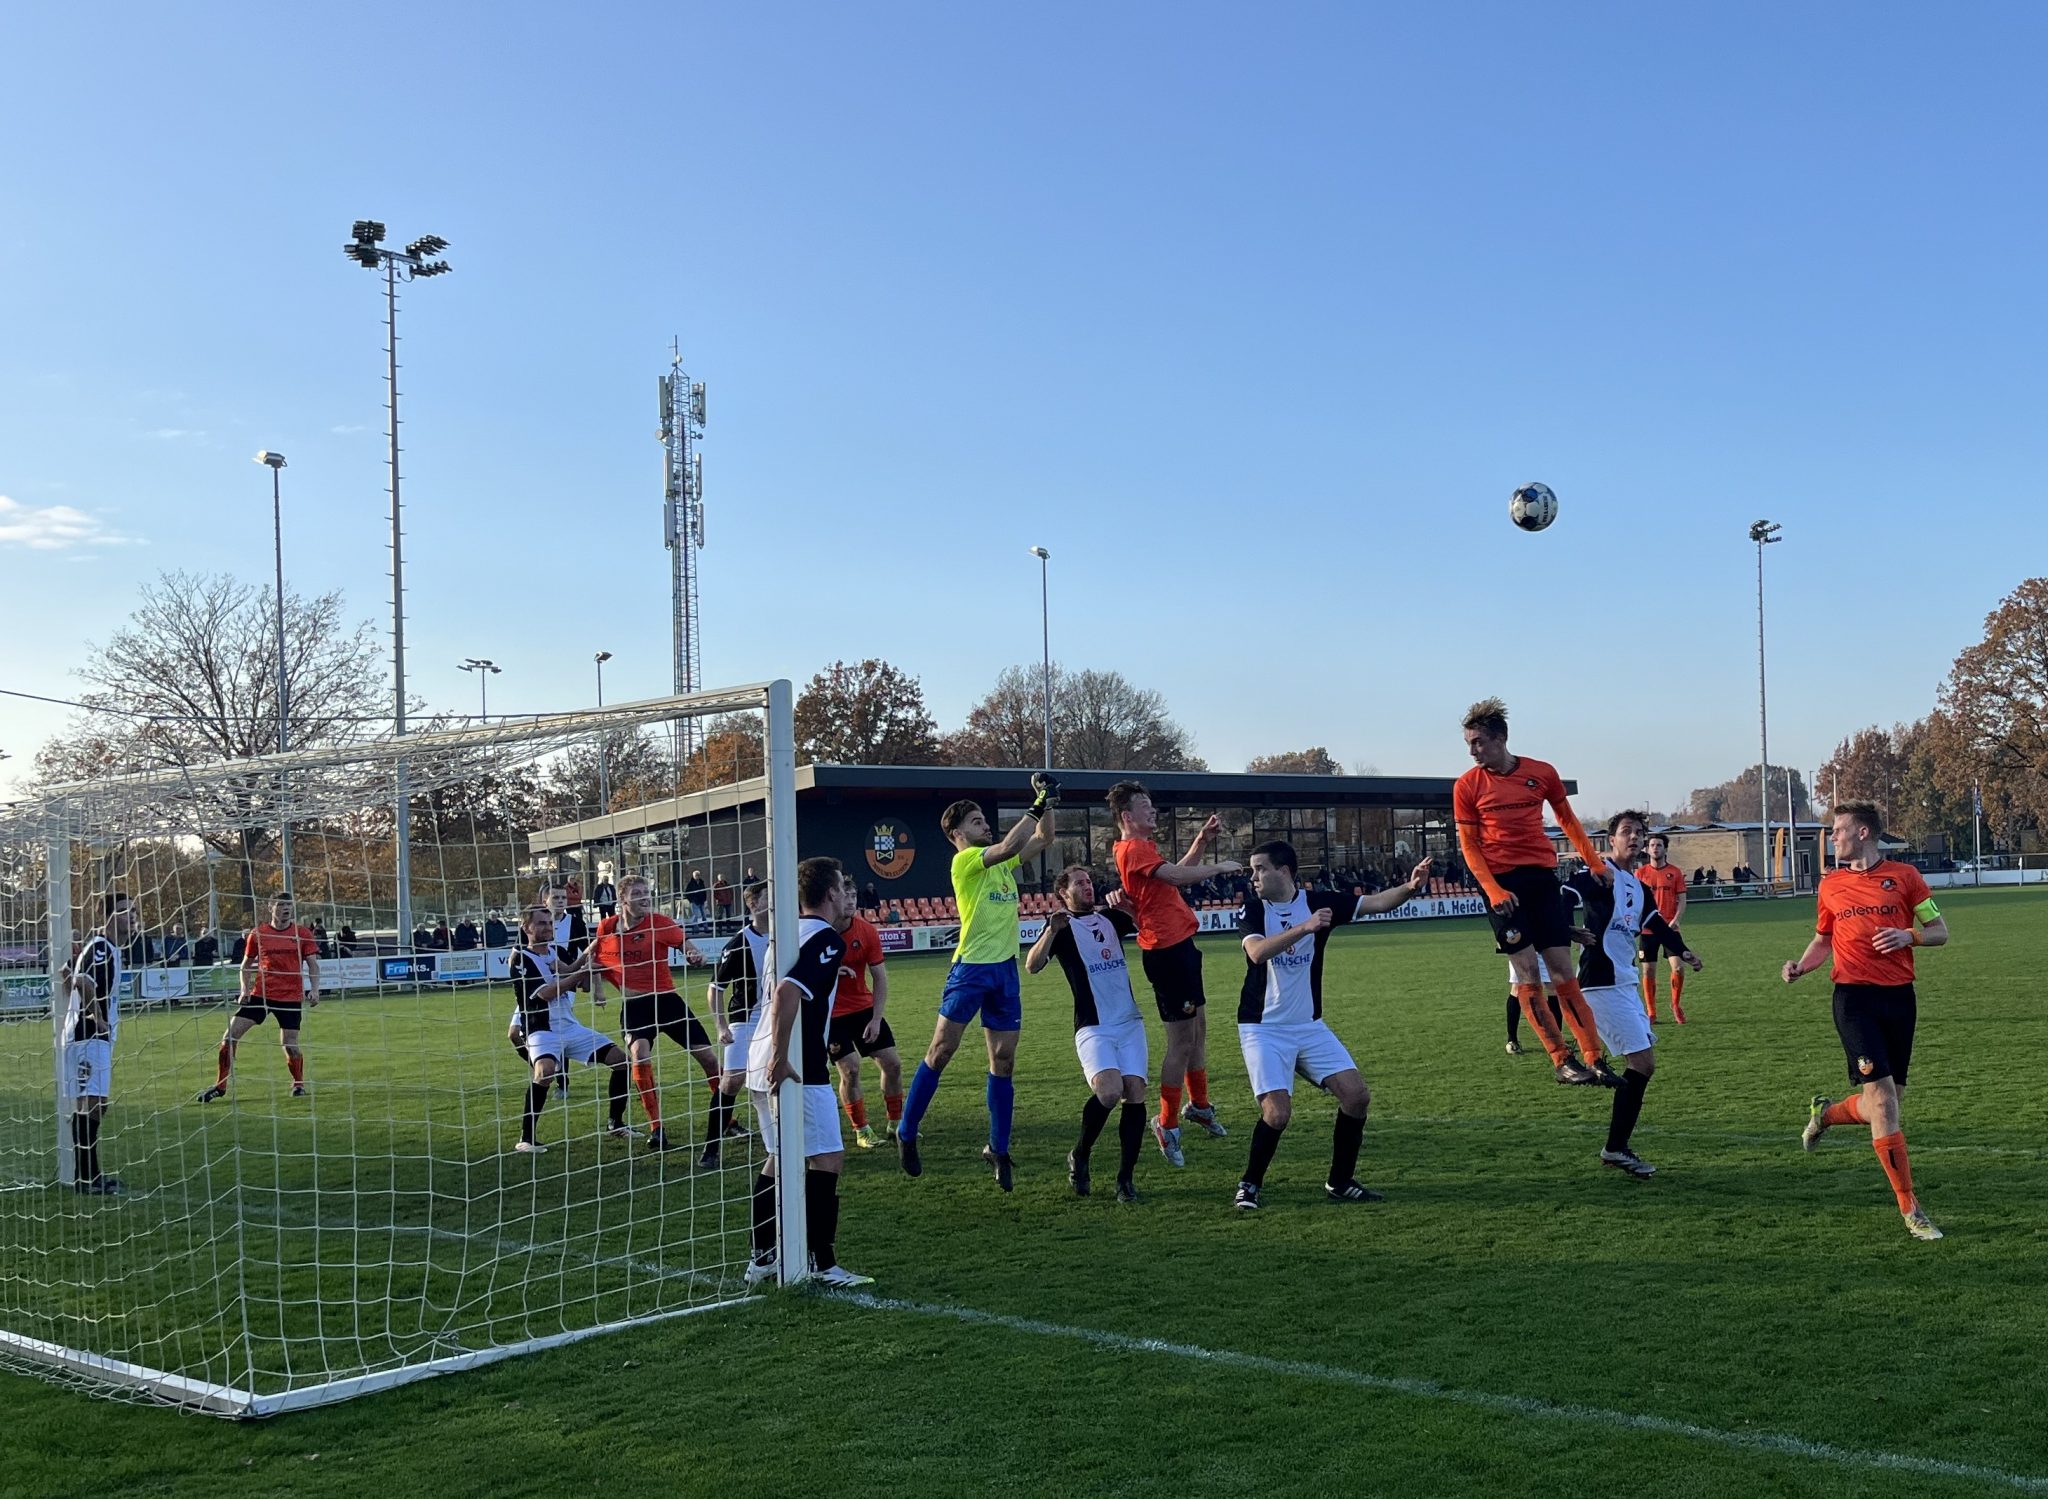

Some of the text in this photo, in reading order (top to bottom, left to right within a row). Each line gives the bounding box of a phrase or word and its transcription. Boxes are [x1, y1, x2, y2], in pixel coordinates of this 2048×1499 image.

[1438, 900, 1450, 915] A.
[1452, 899, 1484, 914] Heide
[1836, 904, 1898, 921] zieleman
[1211, 913, 1226, 929] A.
[1089, 959, 1126, 973] BRUSCHE
